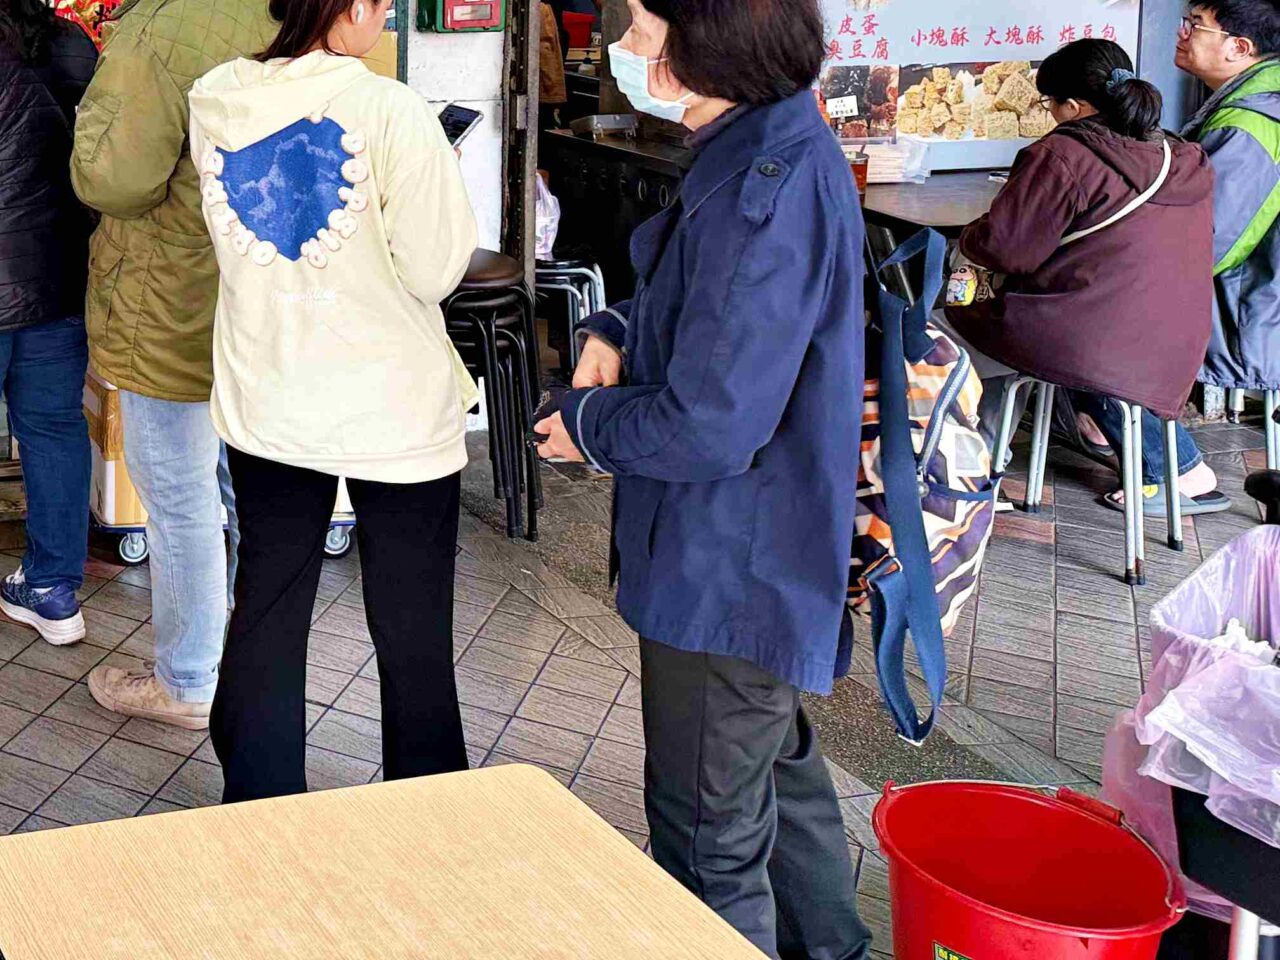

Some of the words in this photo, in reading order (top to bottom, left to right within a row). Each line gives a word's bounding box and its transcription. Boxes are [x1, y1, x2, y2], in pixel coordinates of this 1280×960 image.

[837, 13, 880, 36] 皮蛋
[911, 25, 970, 47] 小塊酥
[984, 23, 1046, 47] 大塊酥
[826, 37, 890, 61] 臭豆腐
